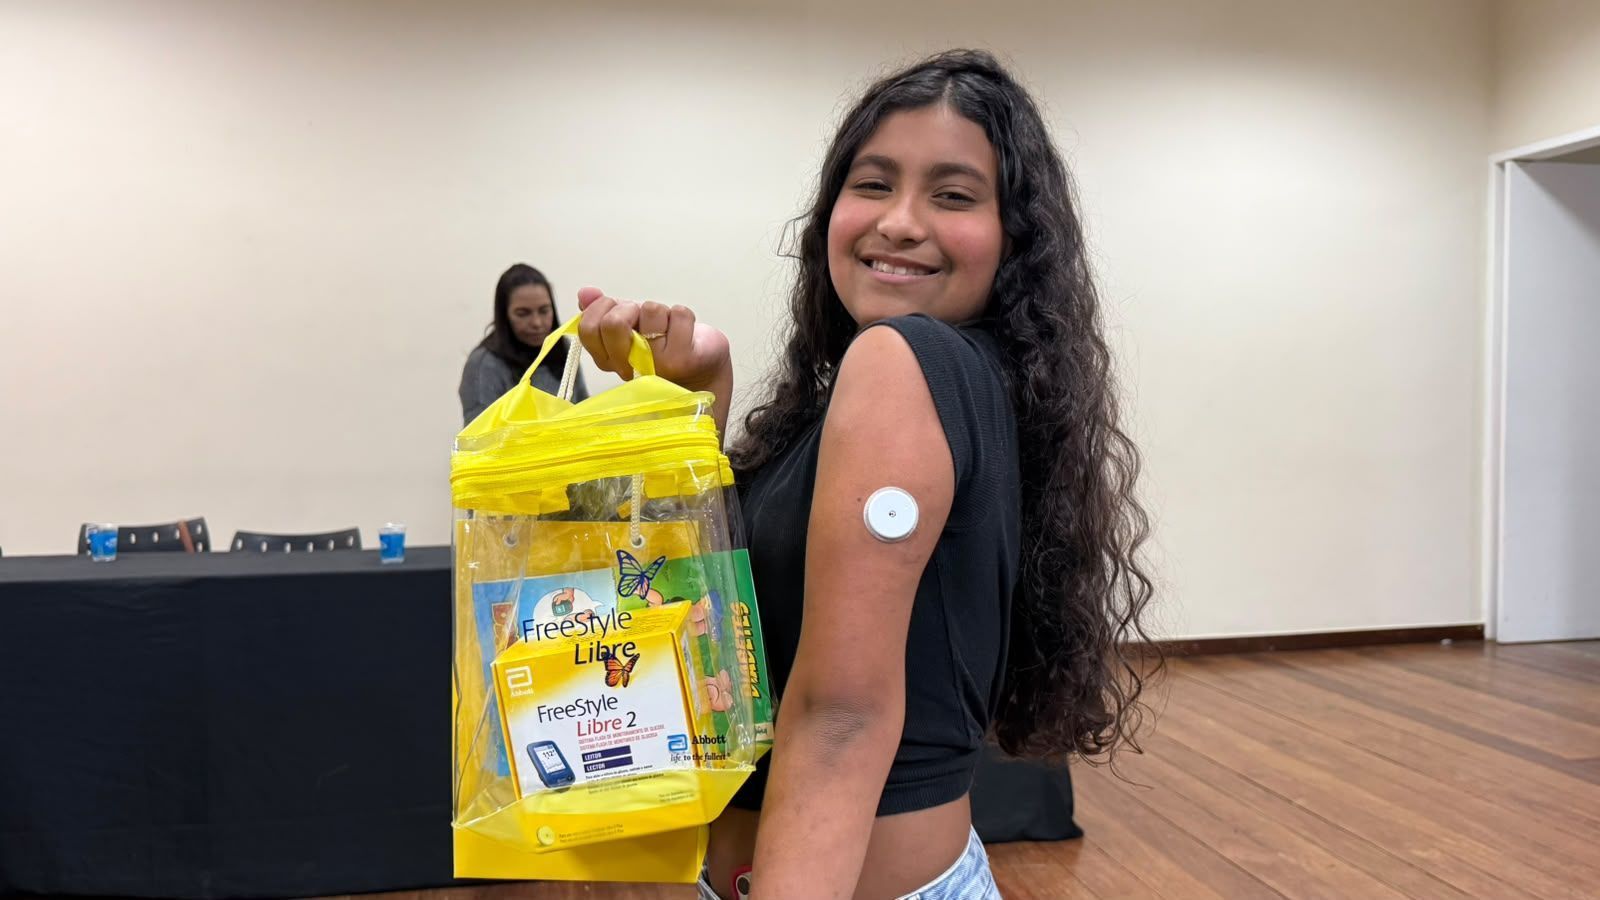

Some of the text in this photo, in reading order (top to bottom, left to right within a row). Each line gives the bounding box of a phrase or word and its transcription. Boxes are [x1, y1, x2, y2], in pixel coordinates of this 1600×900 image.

[522, 607, 633, 643] FreeStyle
[575, 640, 637, 665] Libre
[730, 601, 761, 700] DIABETES
[537, 694, 618, 723] FreeStyle
[577, 711, 637, 737] Libre 2
[692, 735, 727, 745] Abbott
[584, 752, 602, 761] LEITOR
[586, 763, 606, 772] LECTOR
[692, 752, 703, 761] the
